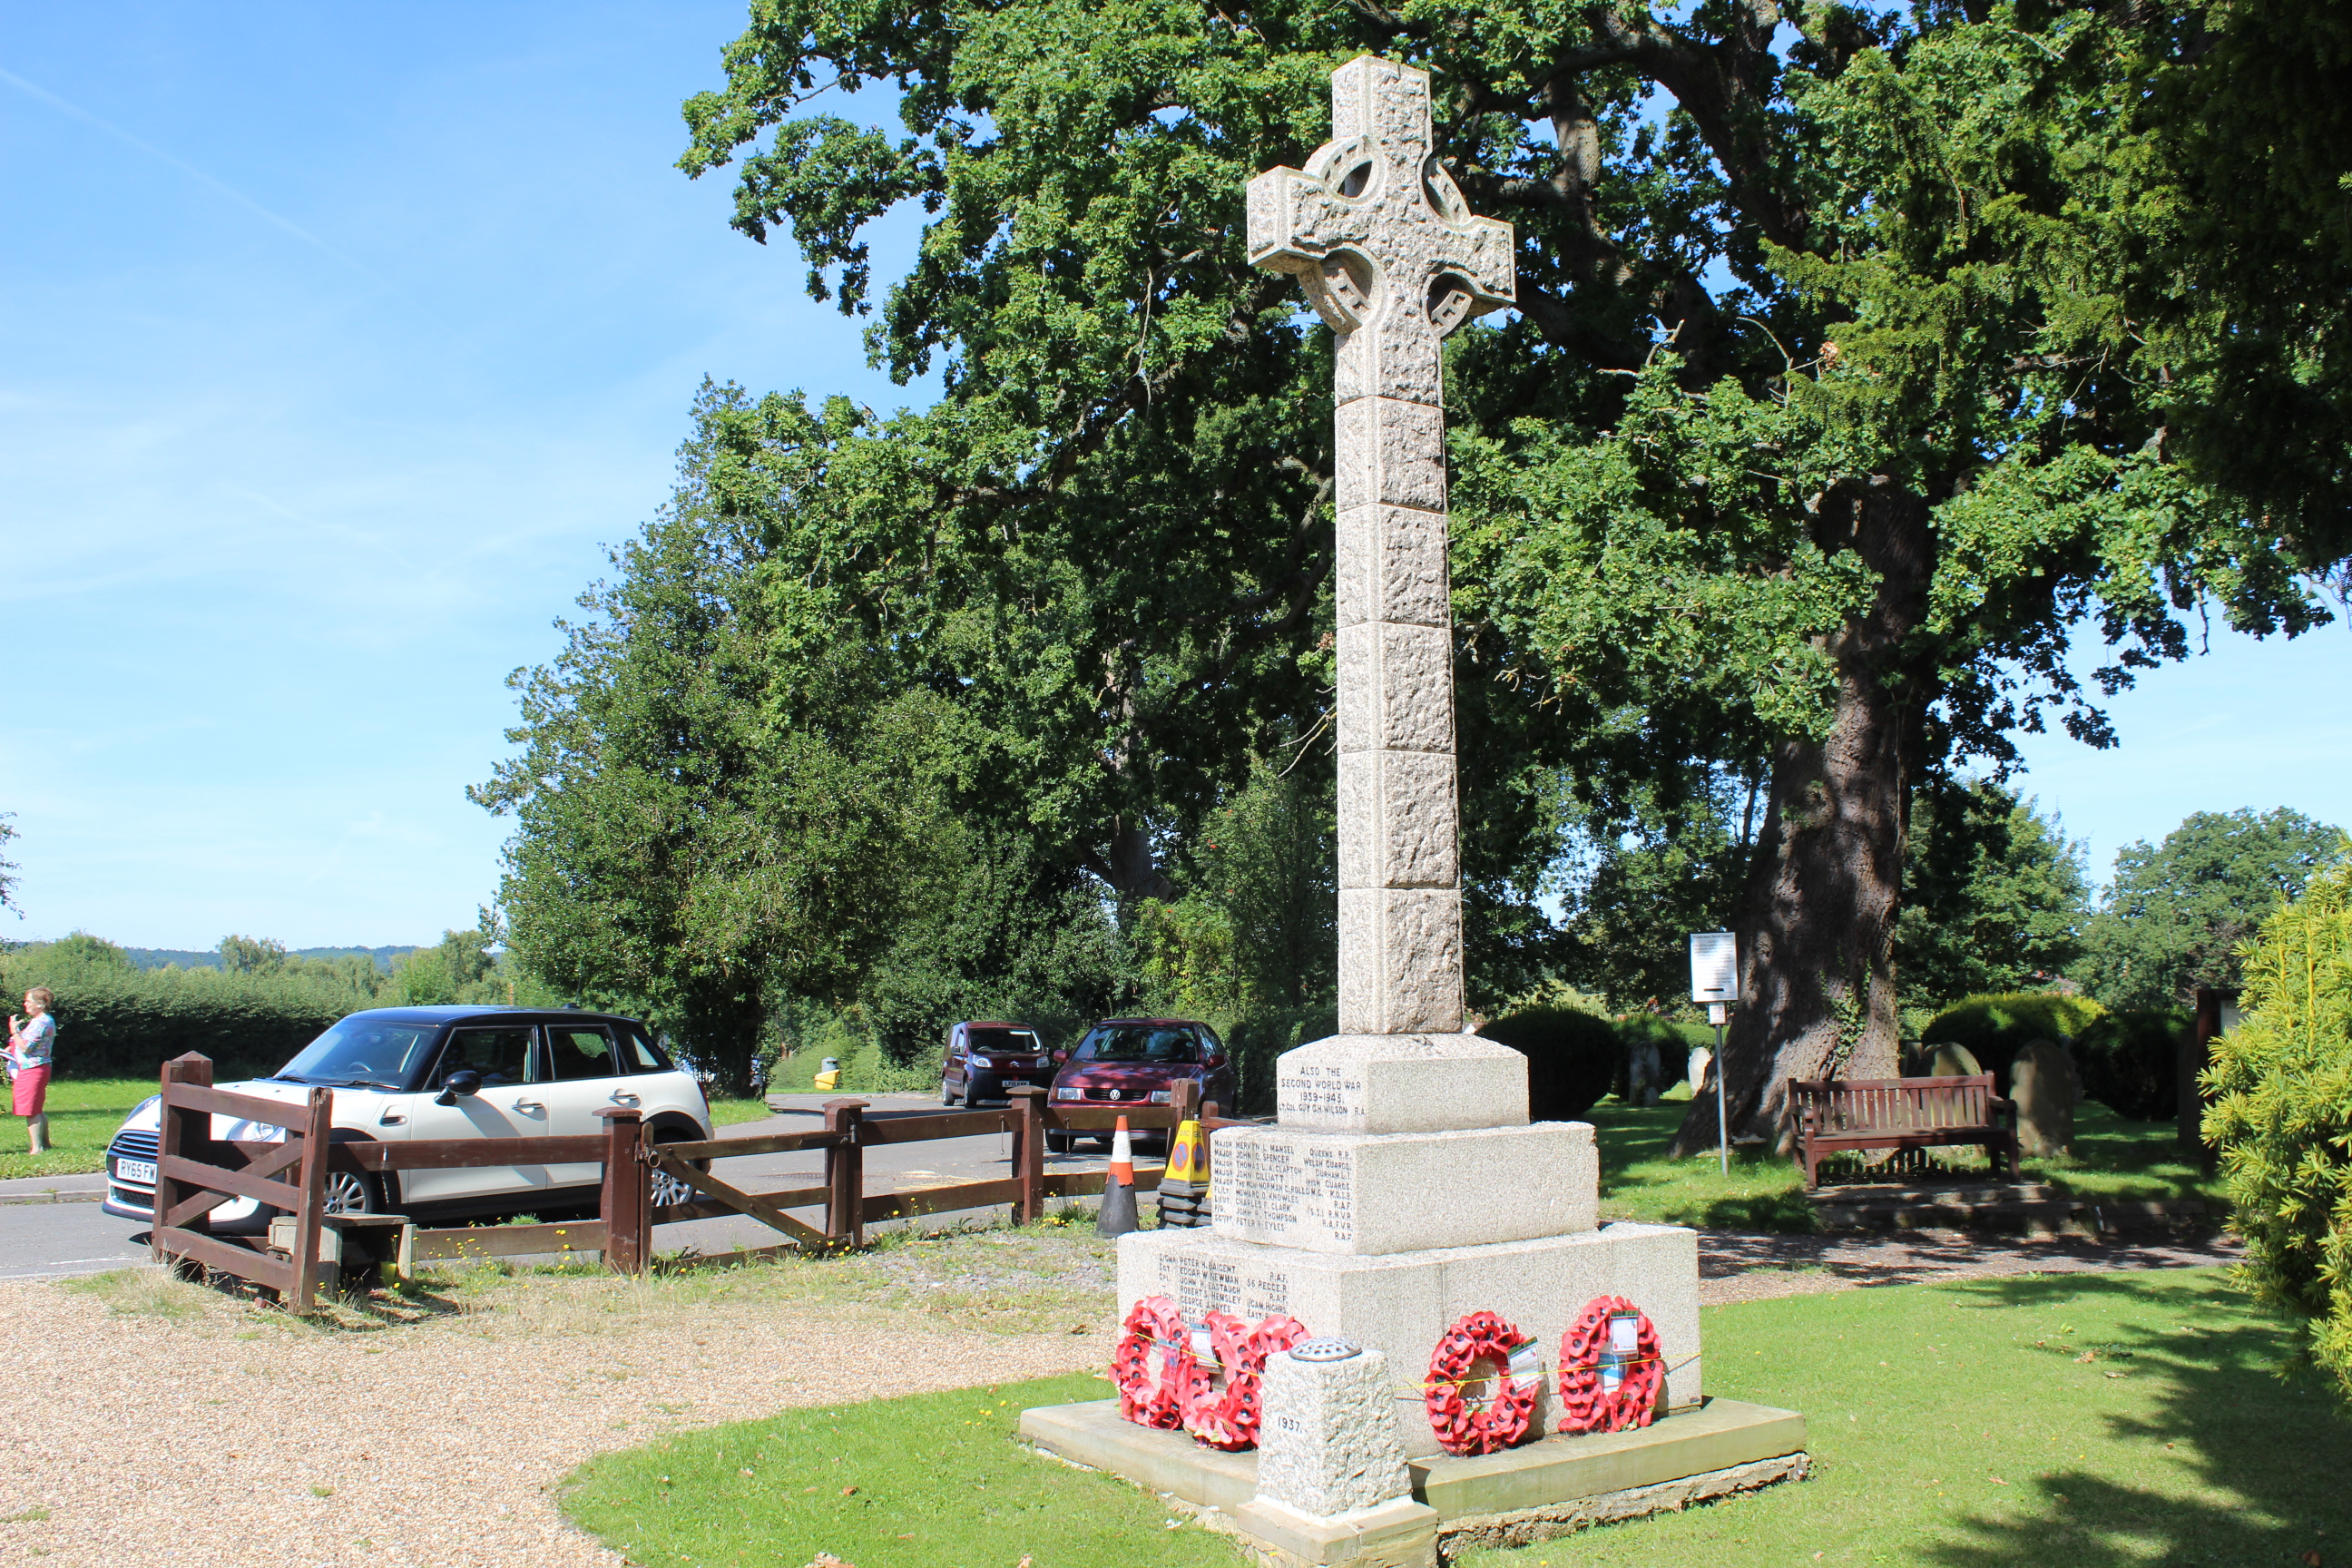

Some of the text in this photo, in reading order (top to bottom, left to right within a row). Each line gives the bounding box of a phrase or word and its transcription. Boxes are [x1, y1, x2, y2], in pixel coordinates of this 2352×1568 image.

[1300, 1067, 1340, 1076] ALSO THE
[1281, 1079, 1361, 1091] SECOND WORLD WAR
[1298, 1103, 1310, 1112] GUY
[1325, 1105, 1348, 1114] WILSON
[1236, 1142, 1259, 1150] MERVYN
[1270, 1144, 1294, 1154] MANSEL
[1263, 1153, 1289, 1162] SPENCER
[122, 1161, 155, 1180] RY65 FW
[1236, 1161, 1259, 1170] THOMAS
[1276, 1165, 1301, 1174] CLAPTON
[1236, 1171, 1251, 1179] JOHN
[1256, 1172, 1283, 1182] GILLIATT
[1259, 1181, 1282, 1191] NORMAN
[1291, 1186, 1308, 1195] ROLLO
[1236, 1189, 1259, 1198] HOWARD
[1269, 1192, 1298, 1203] KNOWLES
[1236, 1198, 1261, 1208] CHARLES
[1271, 1203, 1290, 1211] CLARK
[1264, 1211, 1297, 1223] THOMPSON
[1237, 1218, 1255, 1227] PETER
[1265, 1221, 1285, 1231] EYLES
[1180, 1257, 1199, 1268] PETER
[1181, 1267, 1200, 1278] EDGAR
[1210, 1272, 1239, 1285] NEWMAN
[1247, 1279, 1255, 1288] 56
[1181, 1276, 1196, 1286] JOHN
[1209, 1282, 1240, 1295] EASTAUGH
[1181, 1285, 1201, 1296] ROBERT
[1212, 1291, 1240, 1305] HEMSLEY
[1181, 1296, 1202, 1307] GEORGE
[1211, 1302, 1230, 1313] HAYES
[1181, 1306, 1196, 1315] JACK
